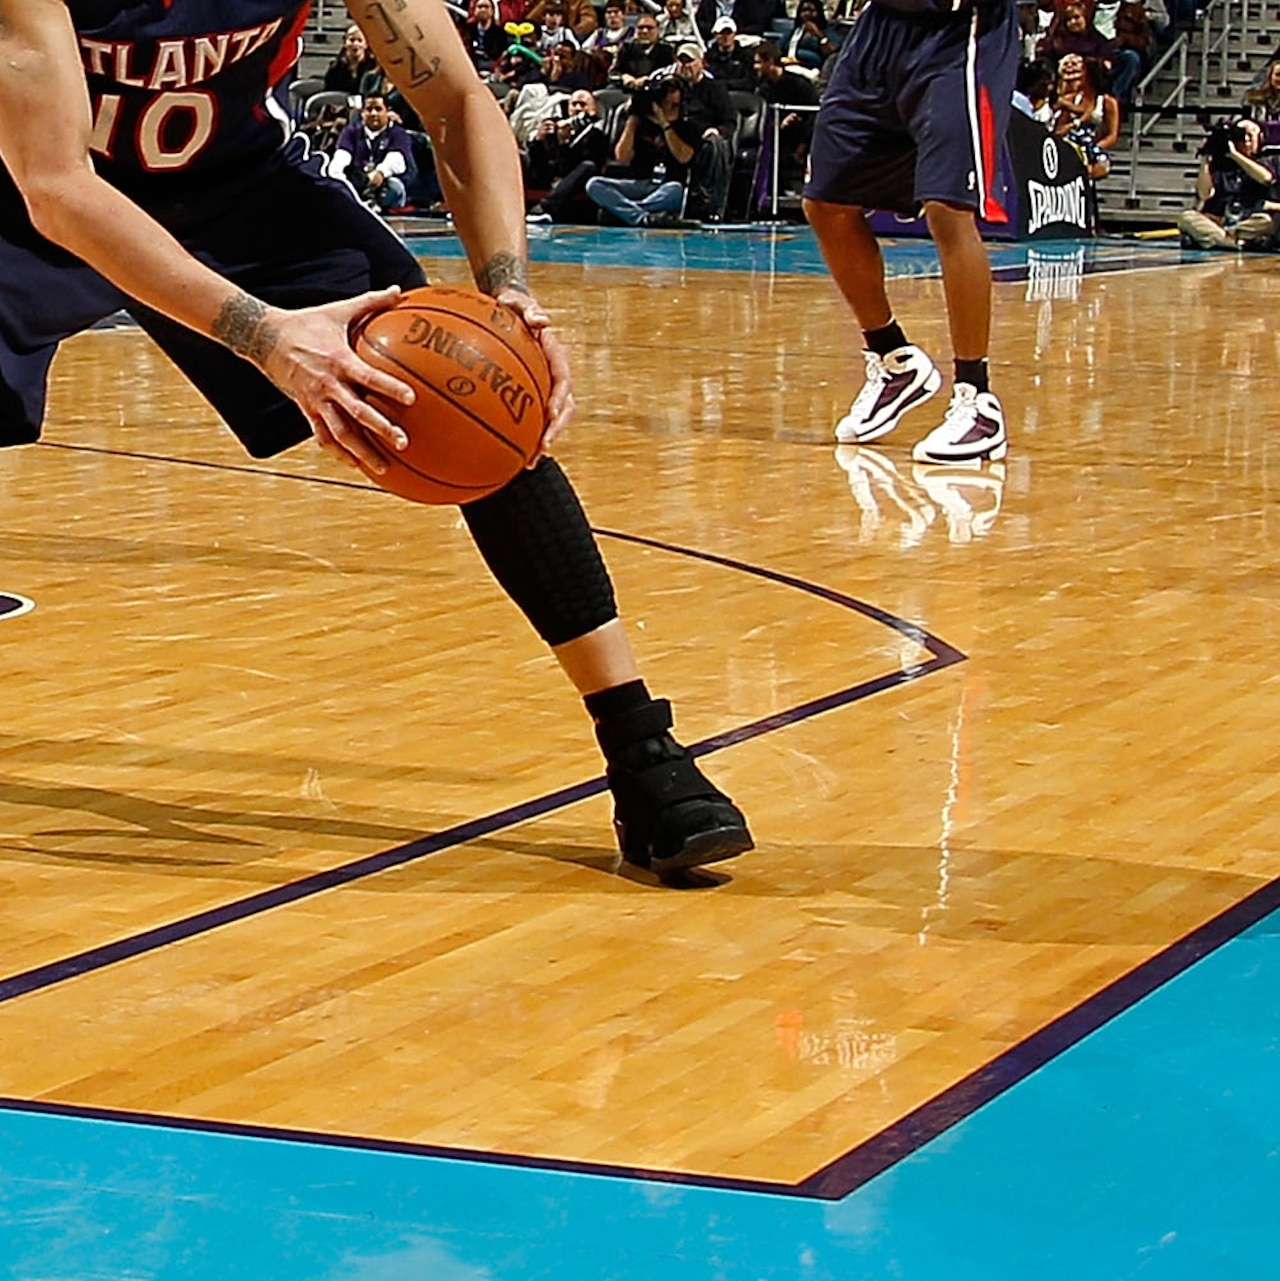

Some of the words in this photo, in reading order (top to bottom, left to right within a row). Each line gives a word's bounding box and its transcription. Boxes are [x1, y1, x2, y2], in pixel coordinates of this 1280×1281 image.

[80, 16, 284, 90] TLANTA
[1028, 176, 1087, 235] SPALDING
[402, 312, 535, 425] SPALDING
